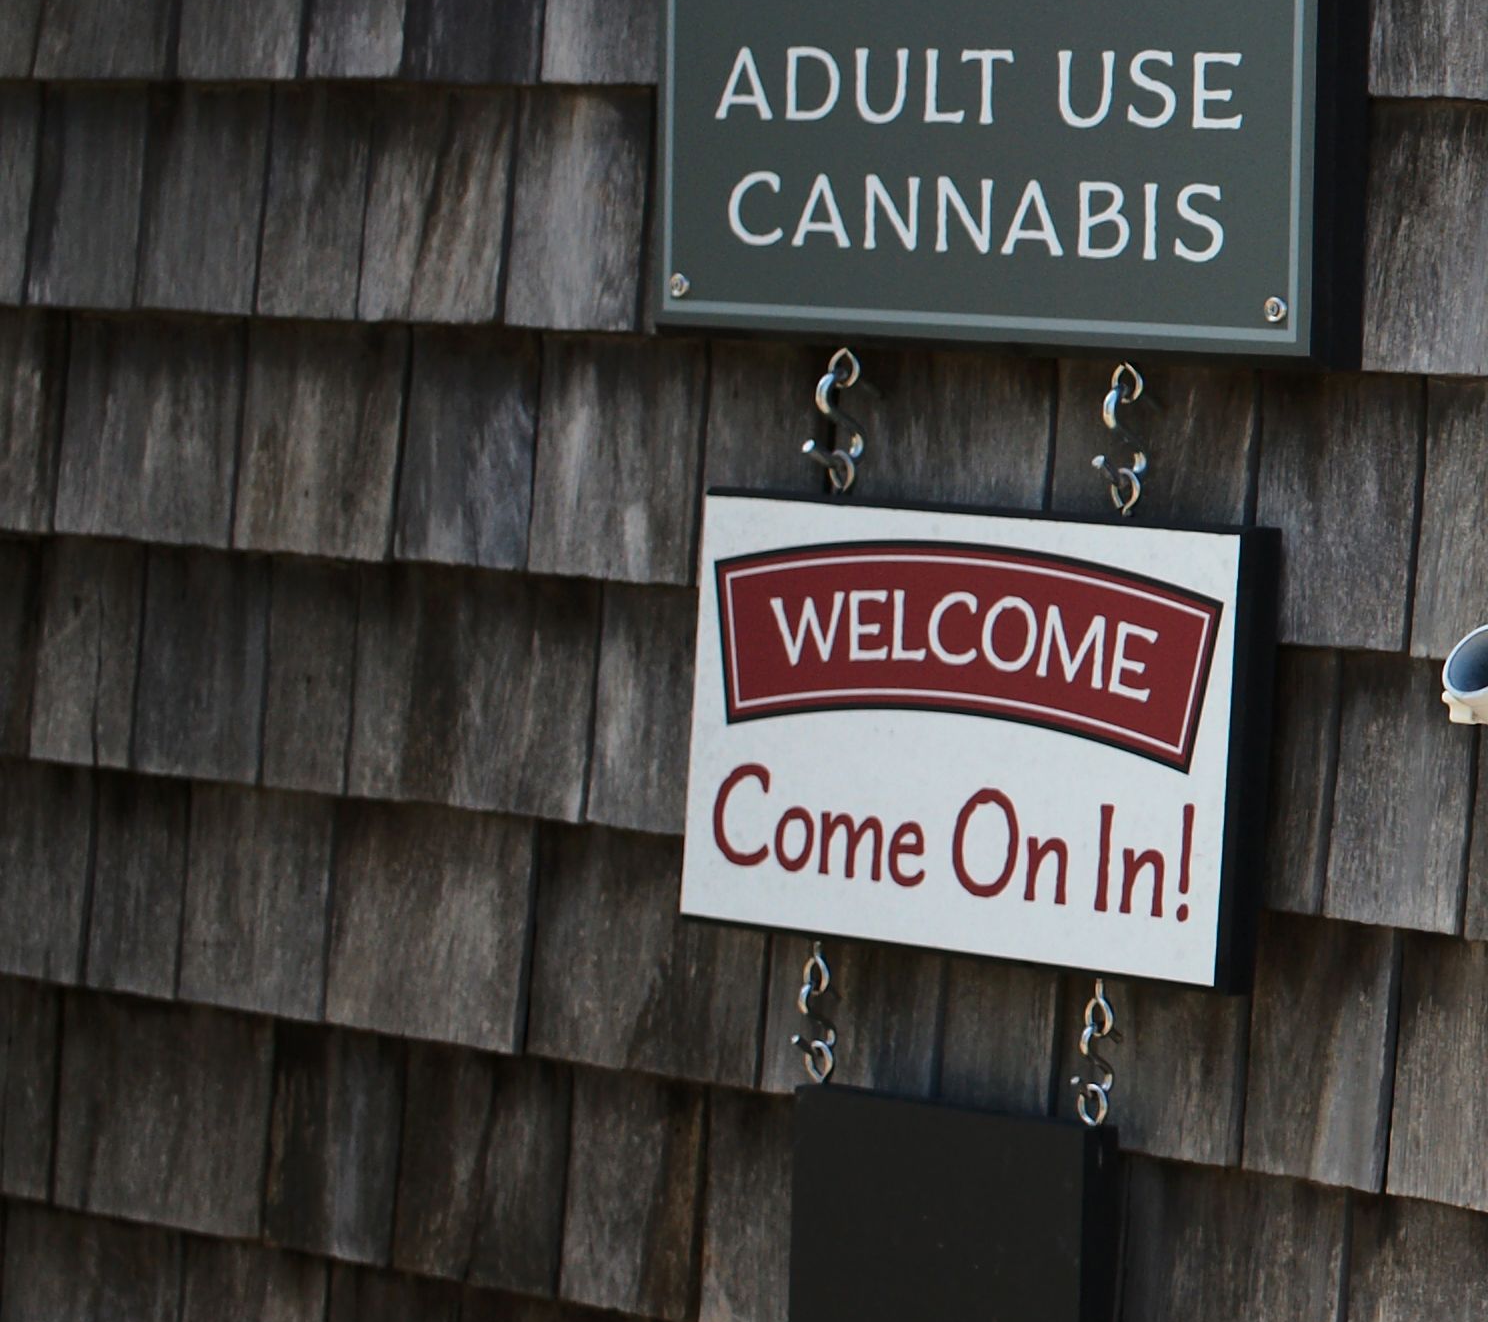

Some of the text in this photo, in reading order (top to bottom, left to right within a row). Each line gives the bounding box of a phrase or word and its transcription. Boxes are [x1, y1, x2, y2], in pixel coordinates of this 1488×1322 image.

[715, 46, 1243, 130] ADULT USE
[727, 171, 1225, 263] CANNABIS
[770, 589, 1160, 702] WELCOME
[712, 762, 1195, 923] Come On In!
